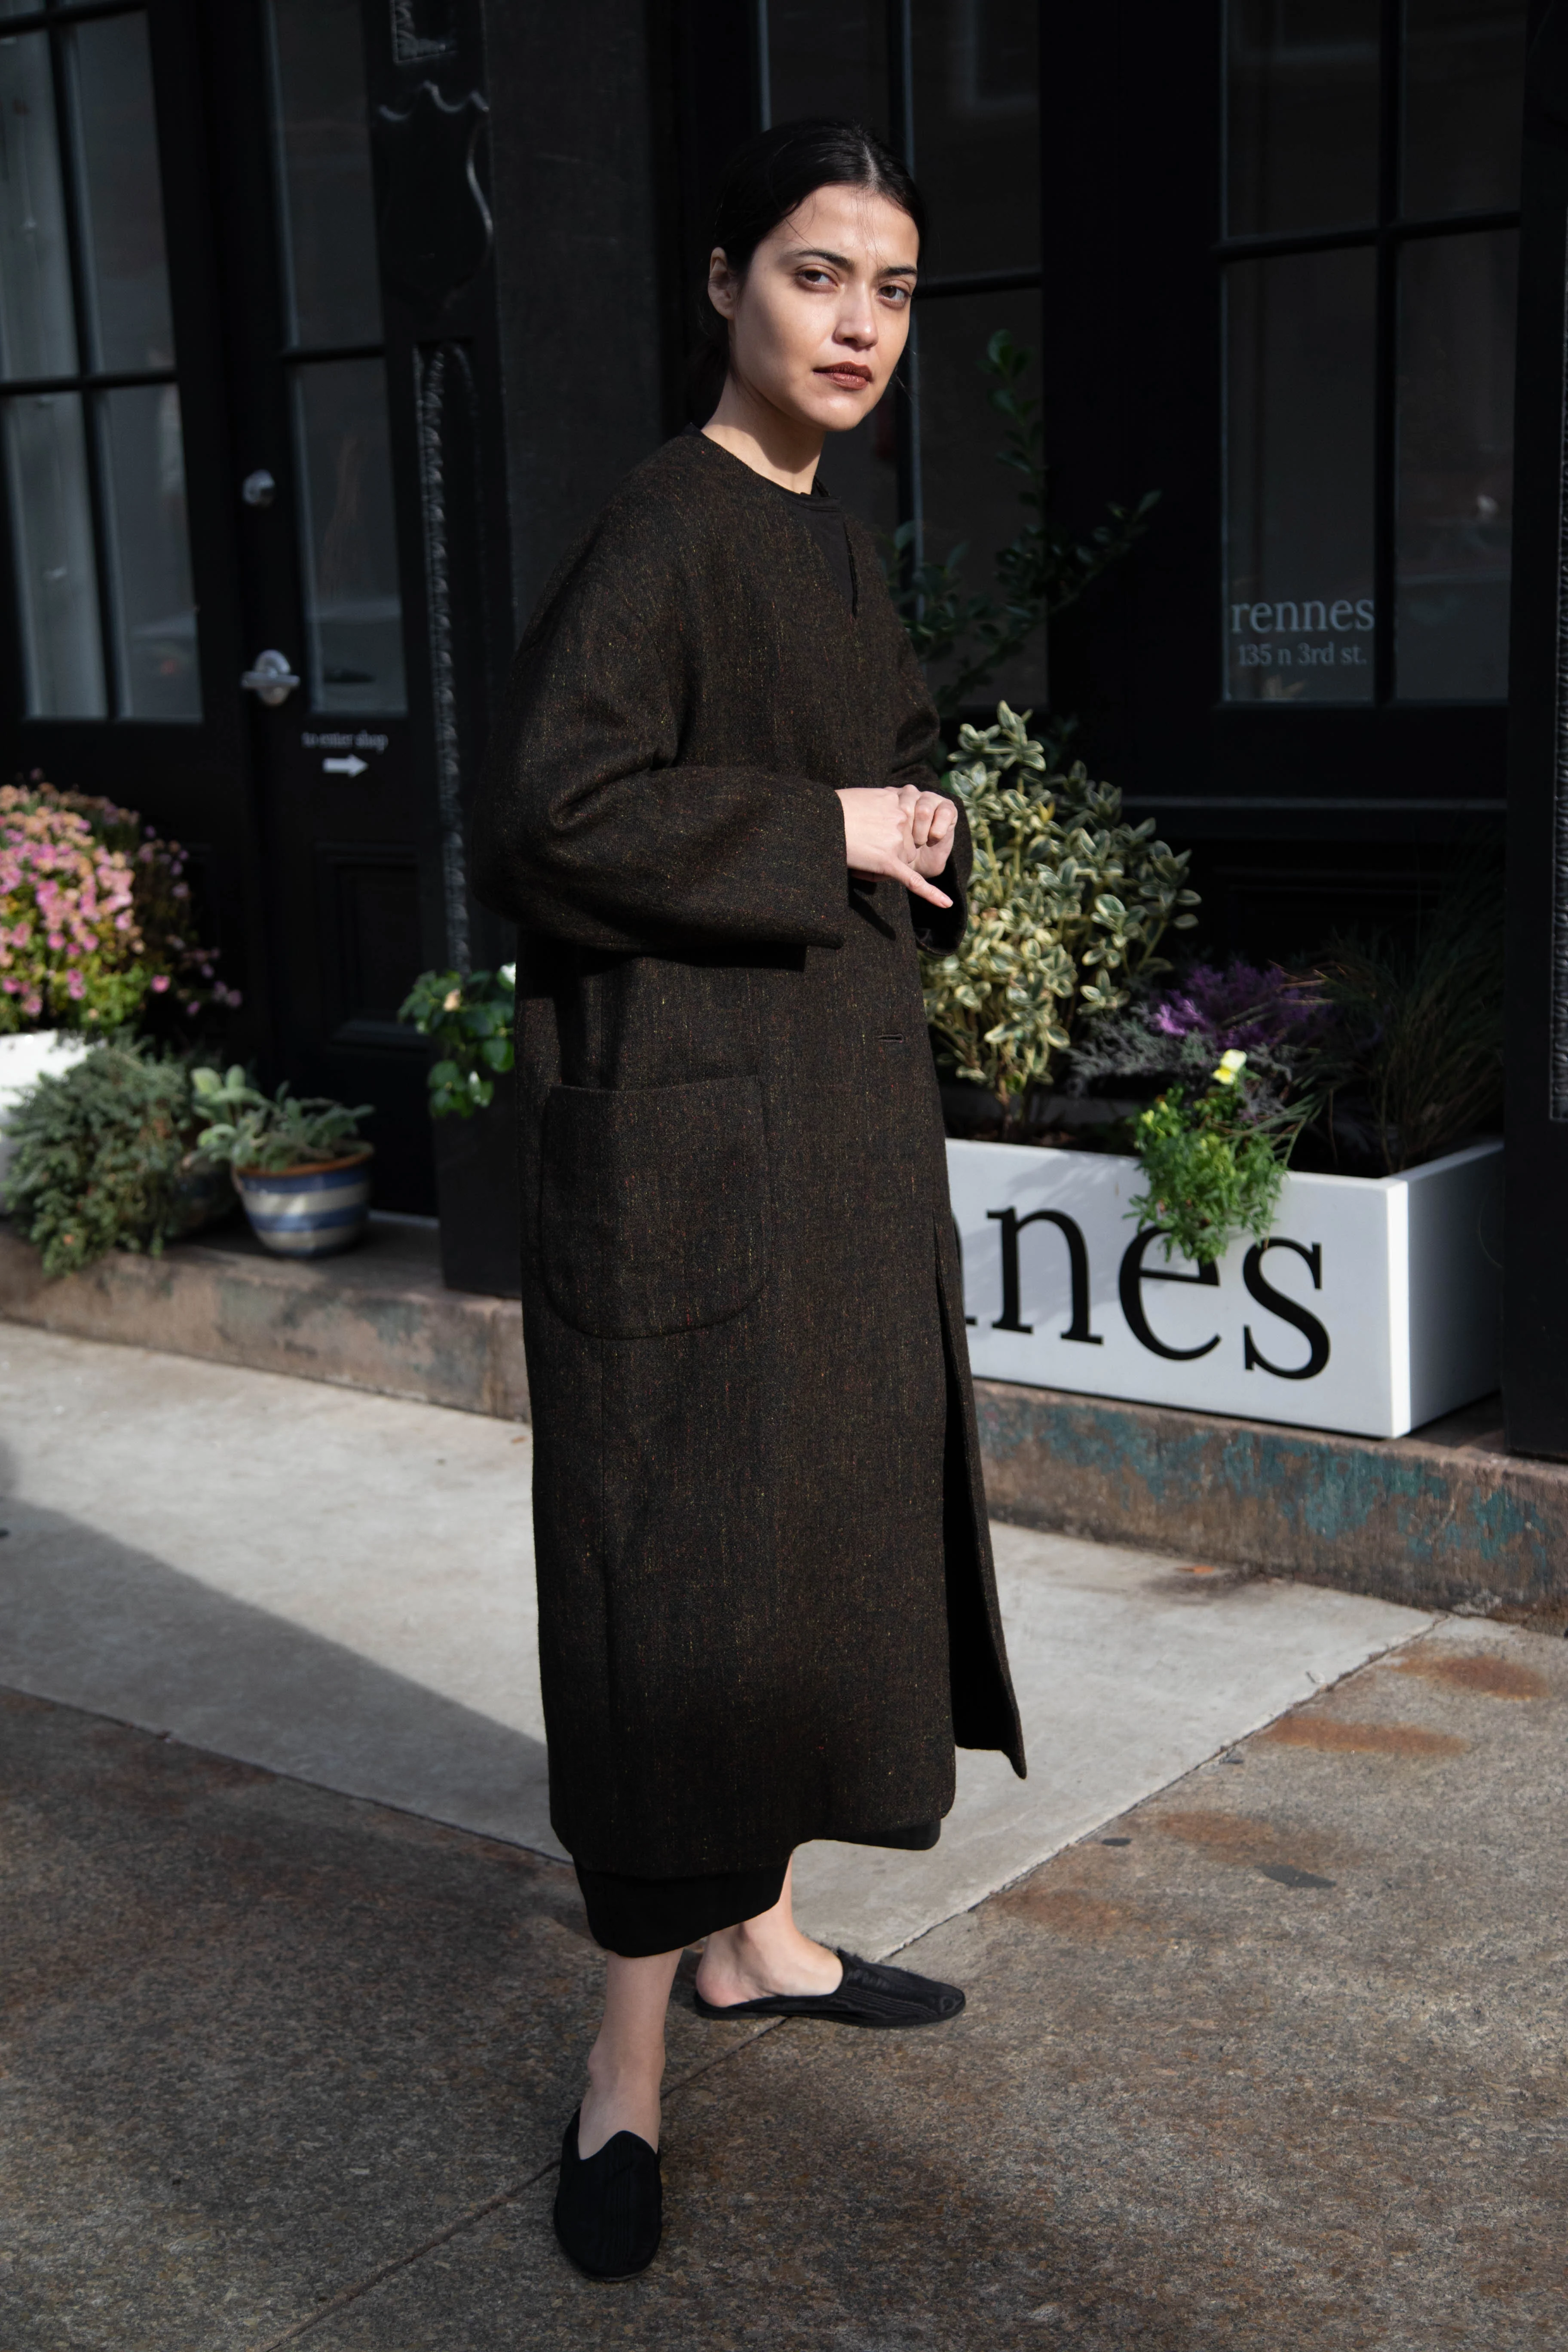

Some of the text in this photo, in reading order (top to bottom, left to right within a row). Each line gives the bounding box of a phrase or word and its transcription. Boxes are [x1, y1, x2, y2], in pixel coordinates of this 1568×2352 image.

[1231, 600, 1375, 634] rennes
[1239, 642, 1367, 667] 135 n 3rd st.
[952, 1207, 1331, 1380] nes
